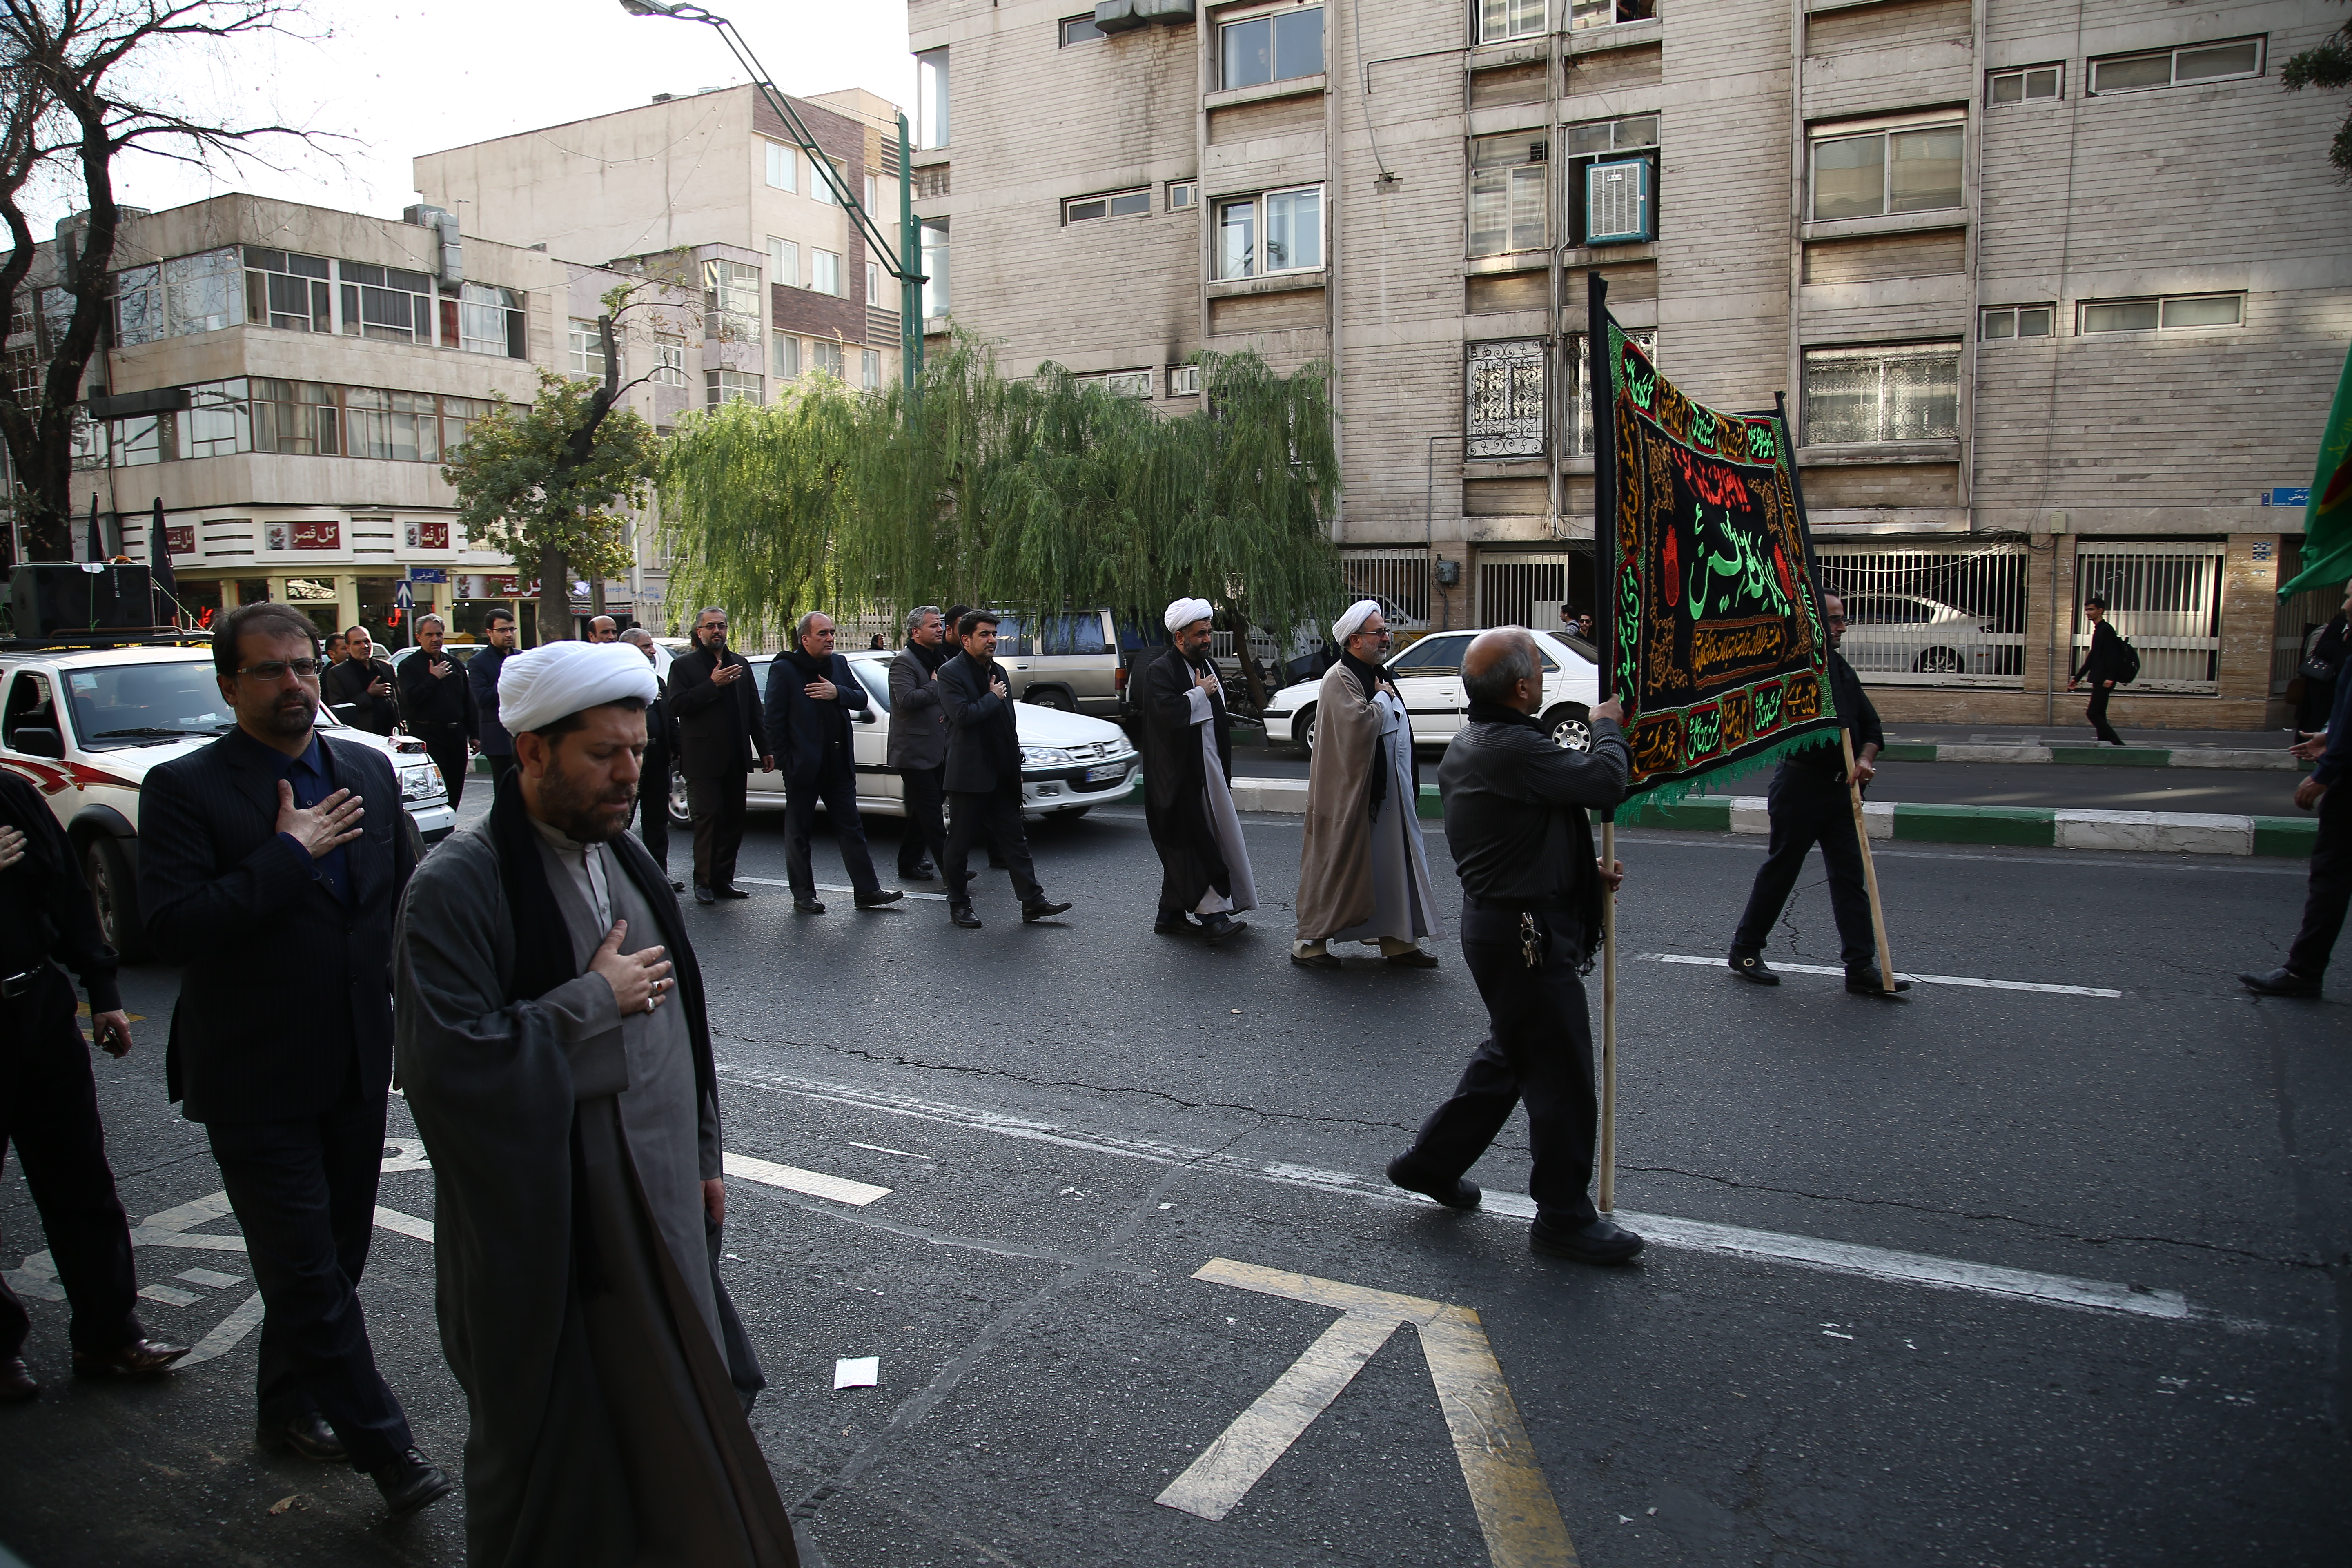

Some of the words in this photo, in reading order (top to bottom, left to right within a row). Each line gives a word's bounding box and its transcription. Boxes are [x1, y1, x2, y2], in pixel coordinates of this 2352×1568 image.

[181, 530, 193, 549] گل
[292, 525, 316, 544] قصر
[317, 526, 337, 543] گل
[419, 526, 434, 546] قصر
[434, 526, 447, 546] گل
